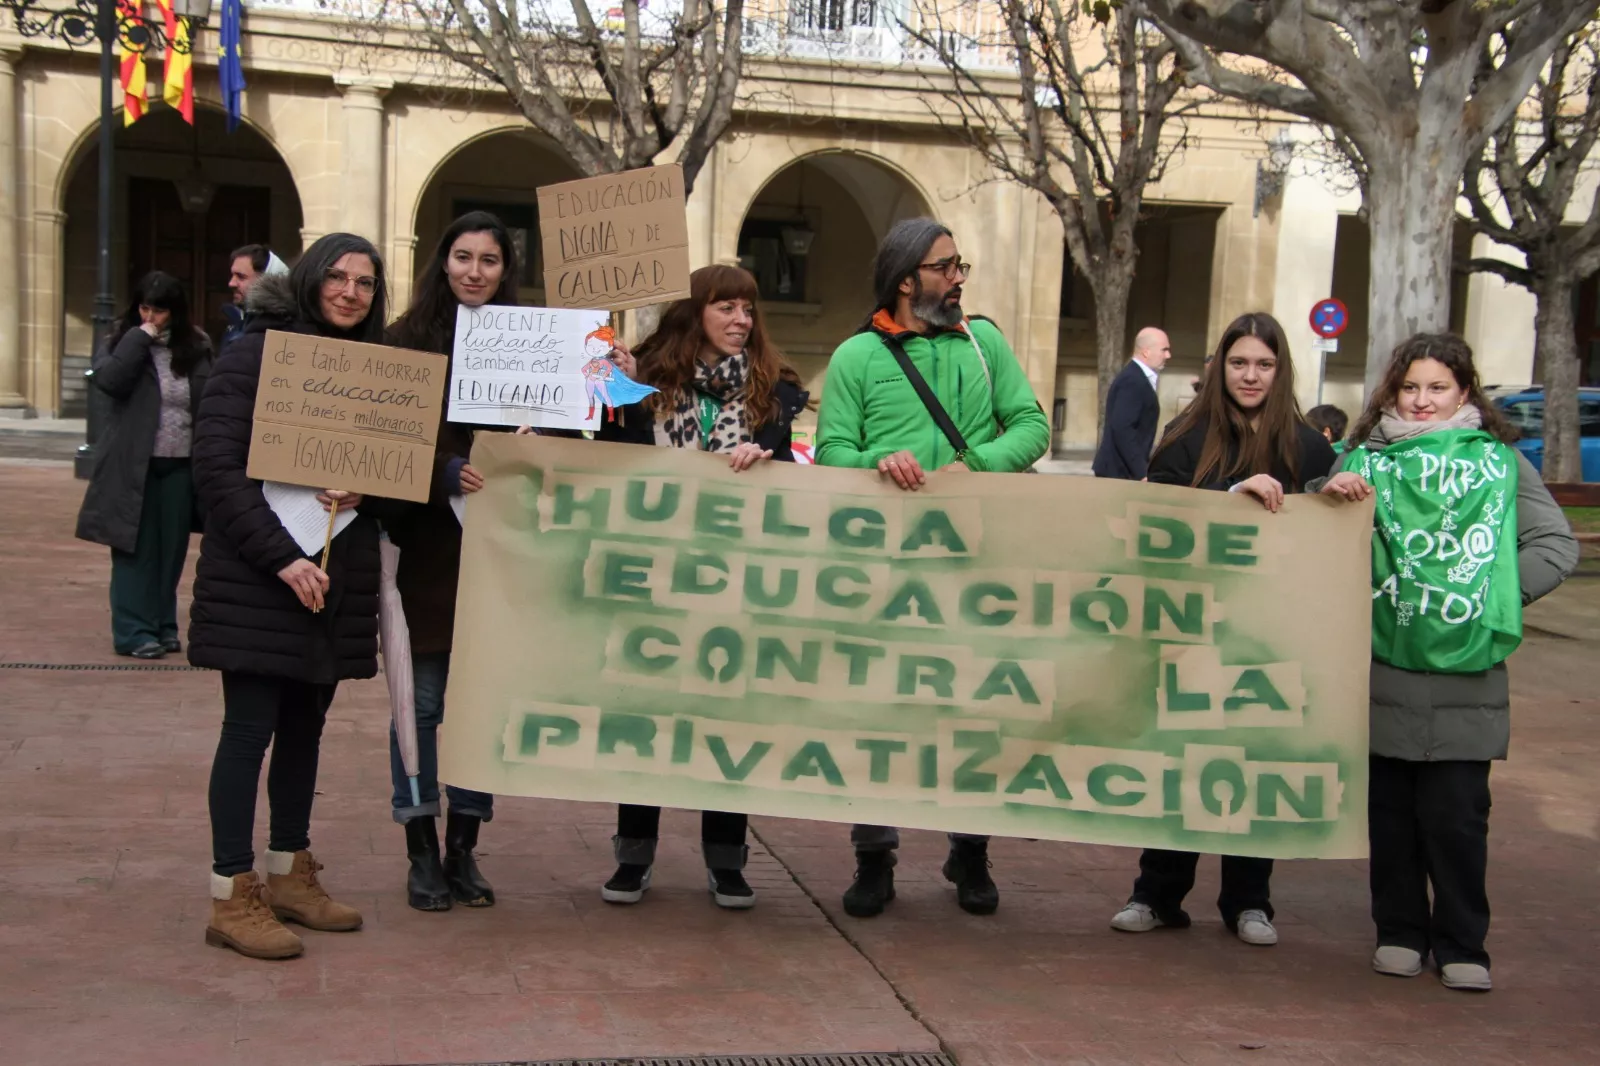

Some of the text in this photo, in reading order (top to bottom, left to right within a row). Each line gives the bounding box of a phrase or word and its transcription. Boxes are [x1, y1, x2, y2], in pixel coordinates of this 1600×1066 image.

[557, 172, 672, 218] EDUCACIÓN
[560, 221, 618, 260] DIGNA
[646, 224, 660, 241] DE
[558, 260, 665, 299] CALIDAD
[462, 328, 565, 348] luchando
[469, 309, 558, 333] DOCENTE
[274, 338, 431, 386] de tanto AHORRAR
[464, 353, 563, 374] también está
[271, 376, 429, 409] en educación
[458, 379, 564, 405] EDUCANDO
[265, 398, 424, 434] nos haréis millonarios
[262, 433, 284, 445] en
[553, 480, 1259, 566] HUELGA DE
[604, 552, 1203, 635] EDUCACIÓN
[624, 626, 1290, 712] CONTRA LA
[519, 713, 1323, 818] PRIVATIZACION
